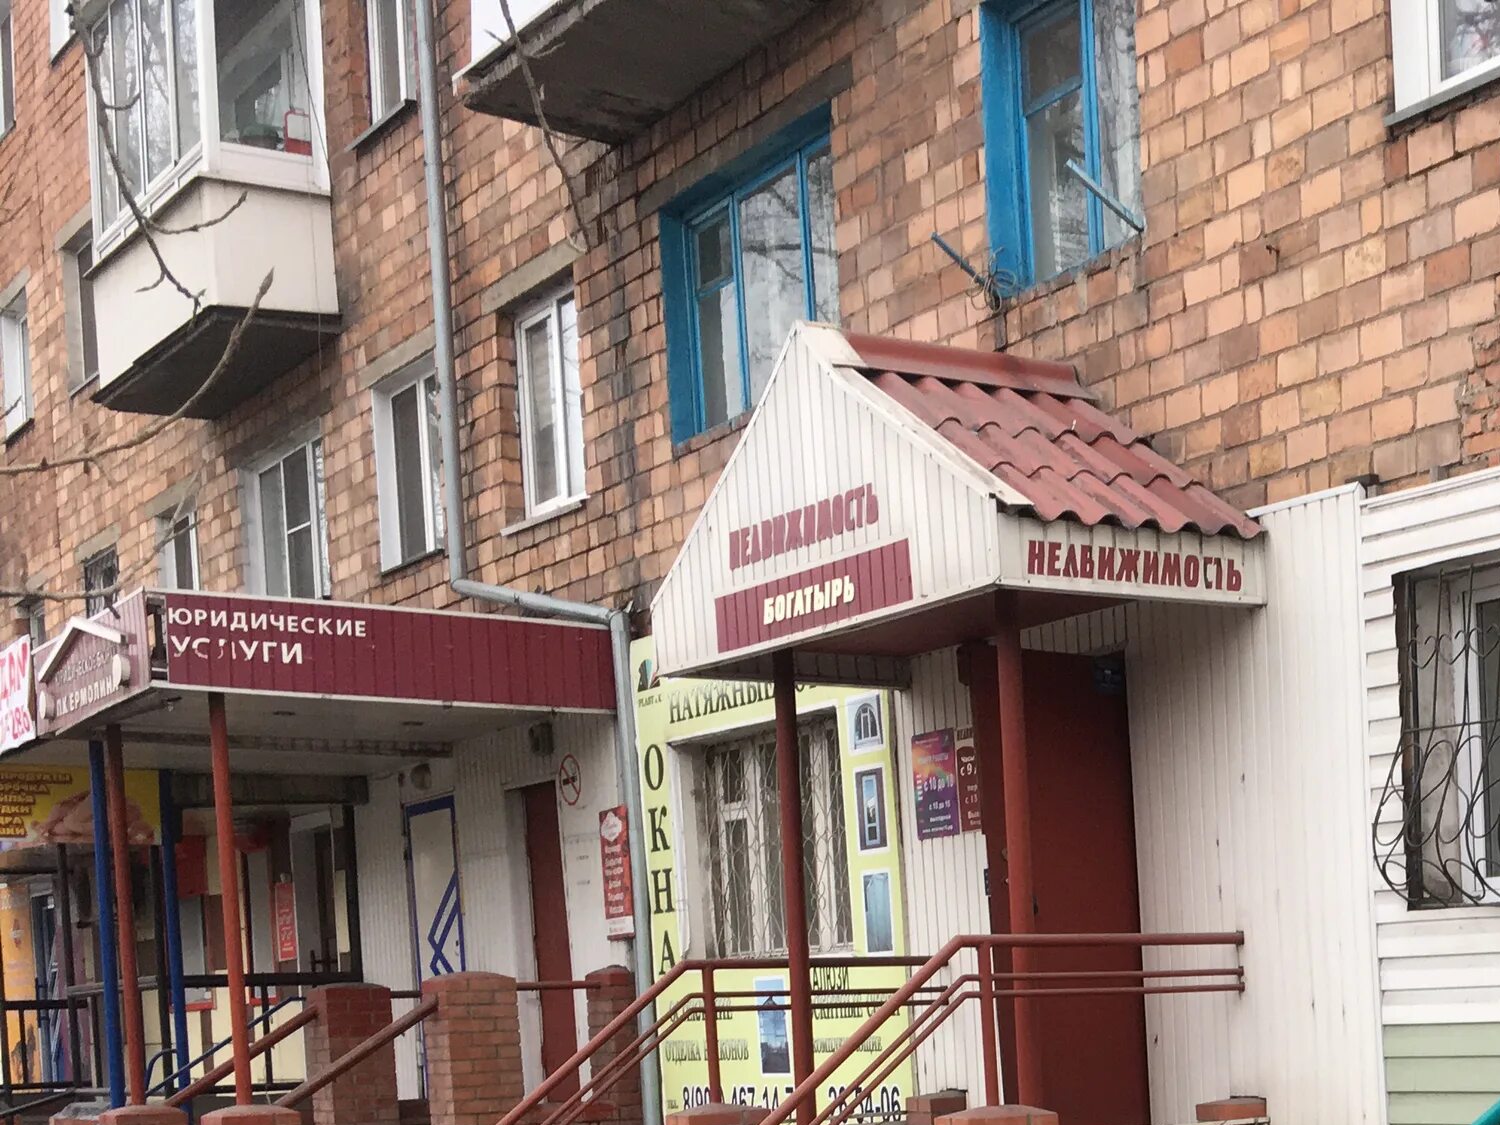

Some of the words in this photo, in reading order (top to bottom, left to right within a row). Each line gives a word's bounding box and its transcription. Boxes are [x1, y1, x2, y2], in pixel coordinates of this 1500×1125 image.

[729, 482, 880, 571] НЕДВИЖИМОСТЬ
[1028, 539, 1242, 592] НЕДВИЖИМОСТЬ
[168, 607, 367, 637] ЮРИДИЧЕСКИЕ
[763, 575, 855, 625] БОГАТЫРЬ
[664, 1041, 702, 1066] ОТДЕЛКА
